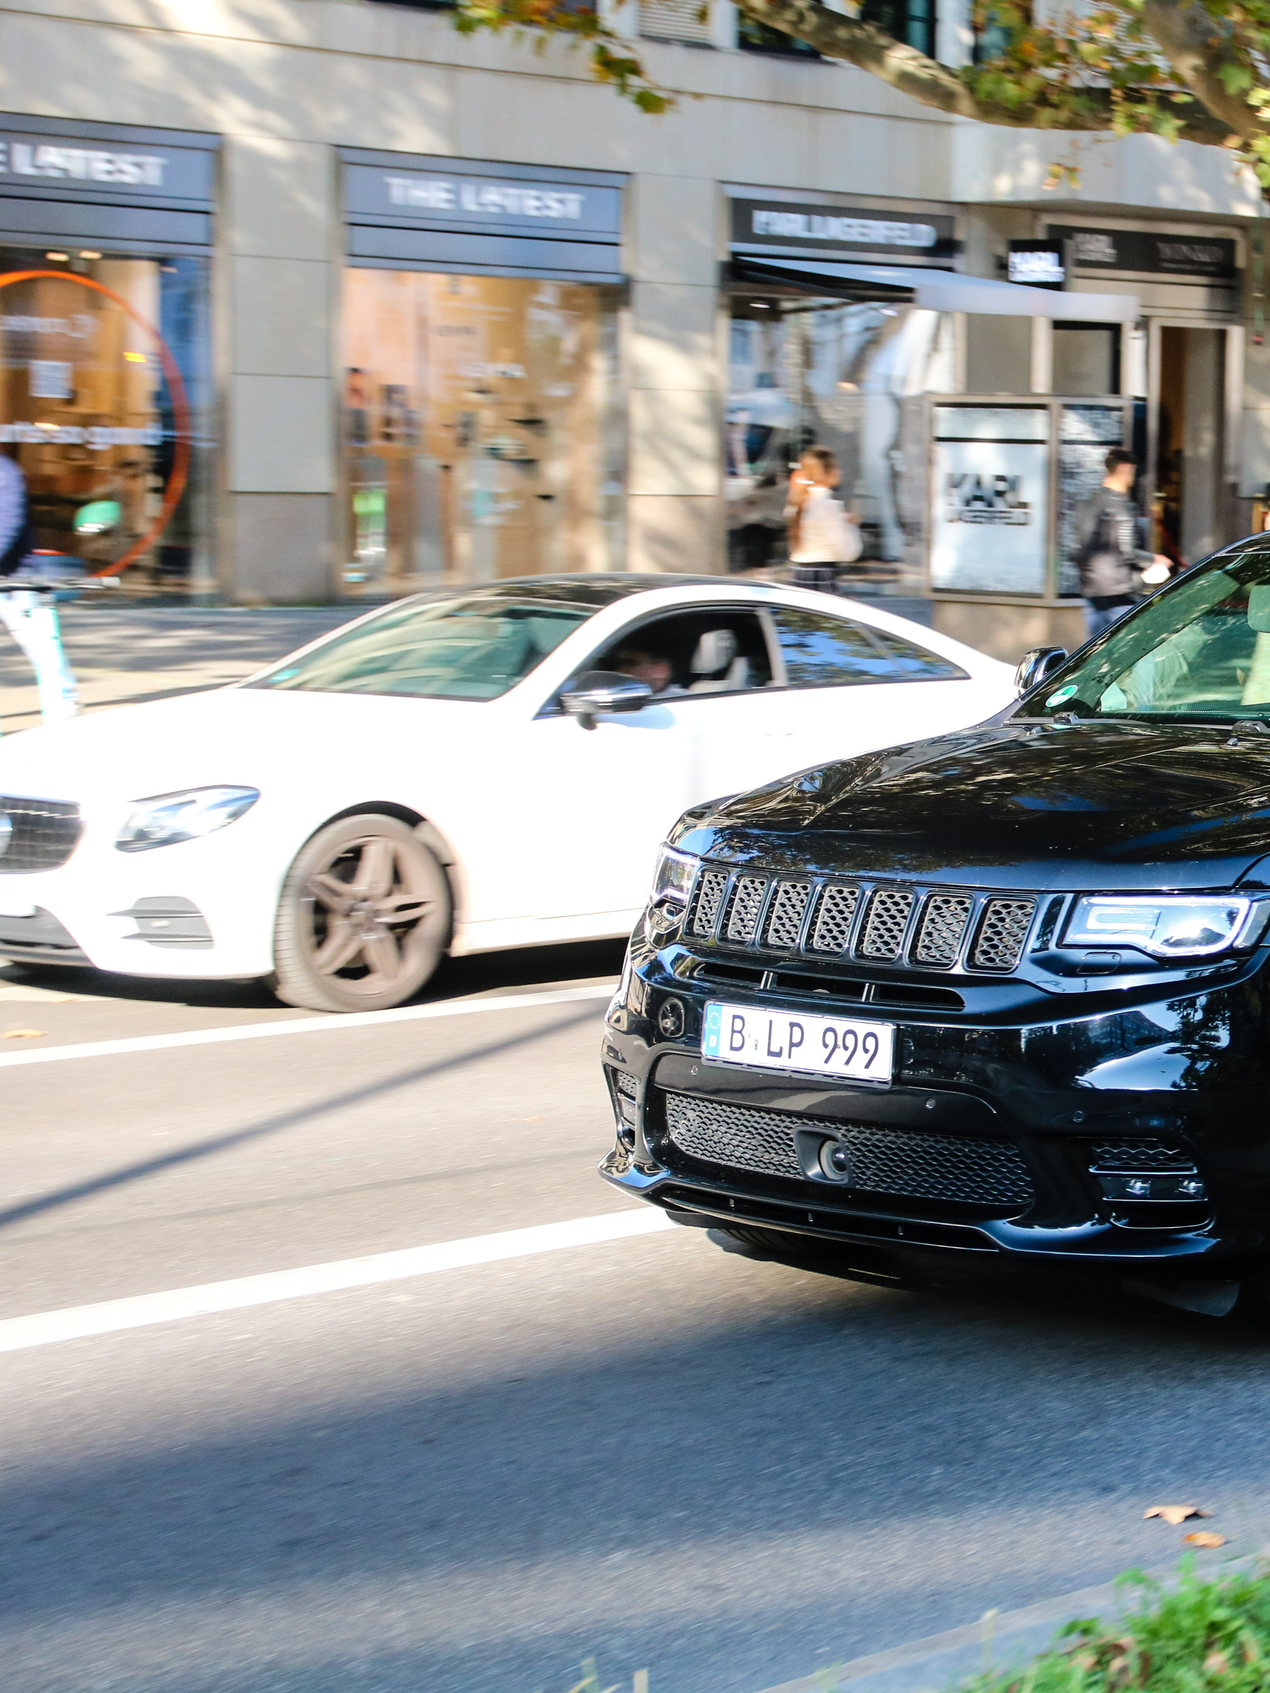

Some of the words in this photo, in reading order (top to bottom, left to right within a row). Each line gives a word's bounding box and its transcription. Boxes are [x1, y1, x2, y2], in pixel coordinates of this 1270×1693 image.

[10, 142, 169, 186] LATEST
[384, 177, 457, 210] THE
[459, 183, 585, 220] LATEST
[946, 473, 1029, 508] KARL
[729, 1014, 746, 1052] B
[767, 1019, 805, 1060] LP
[822, 1026, 879, 1070] 999
